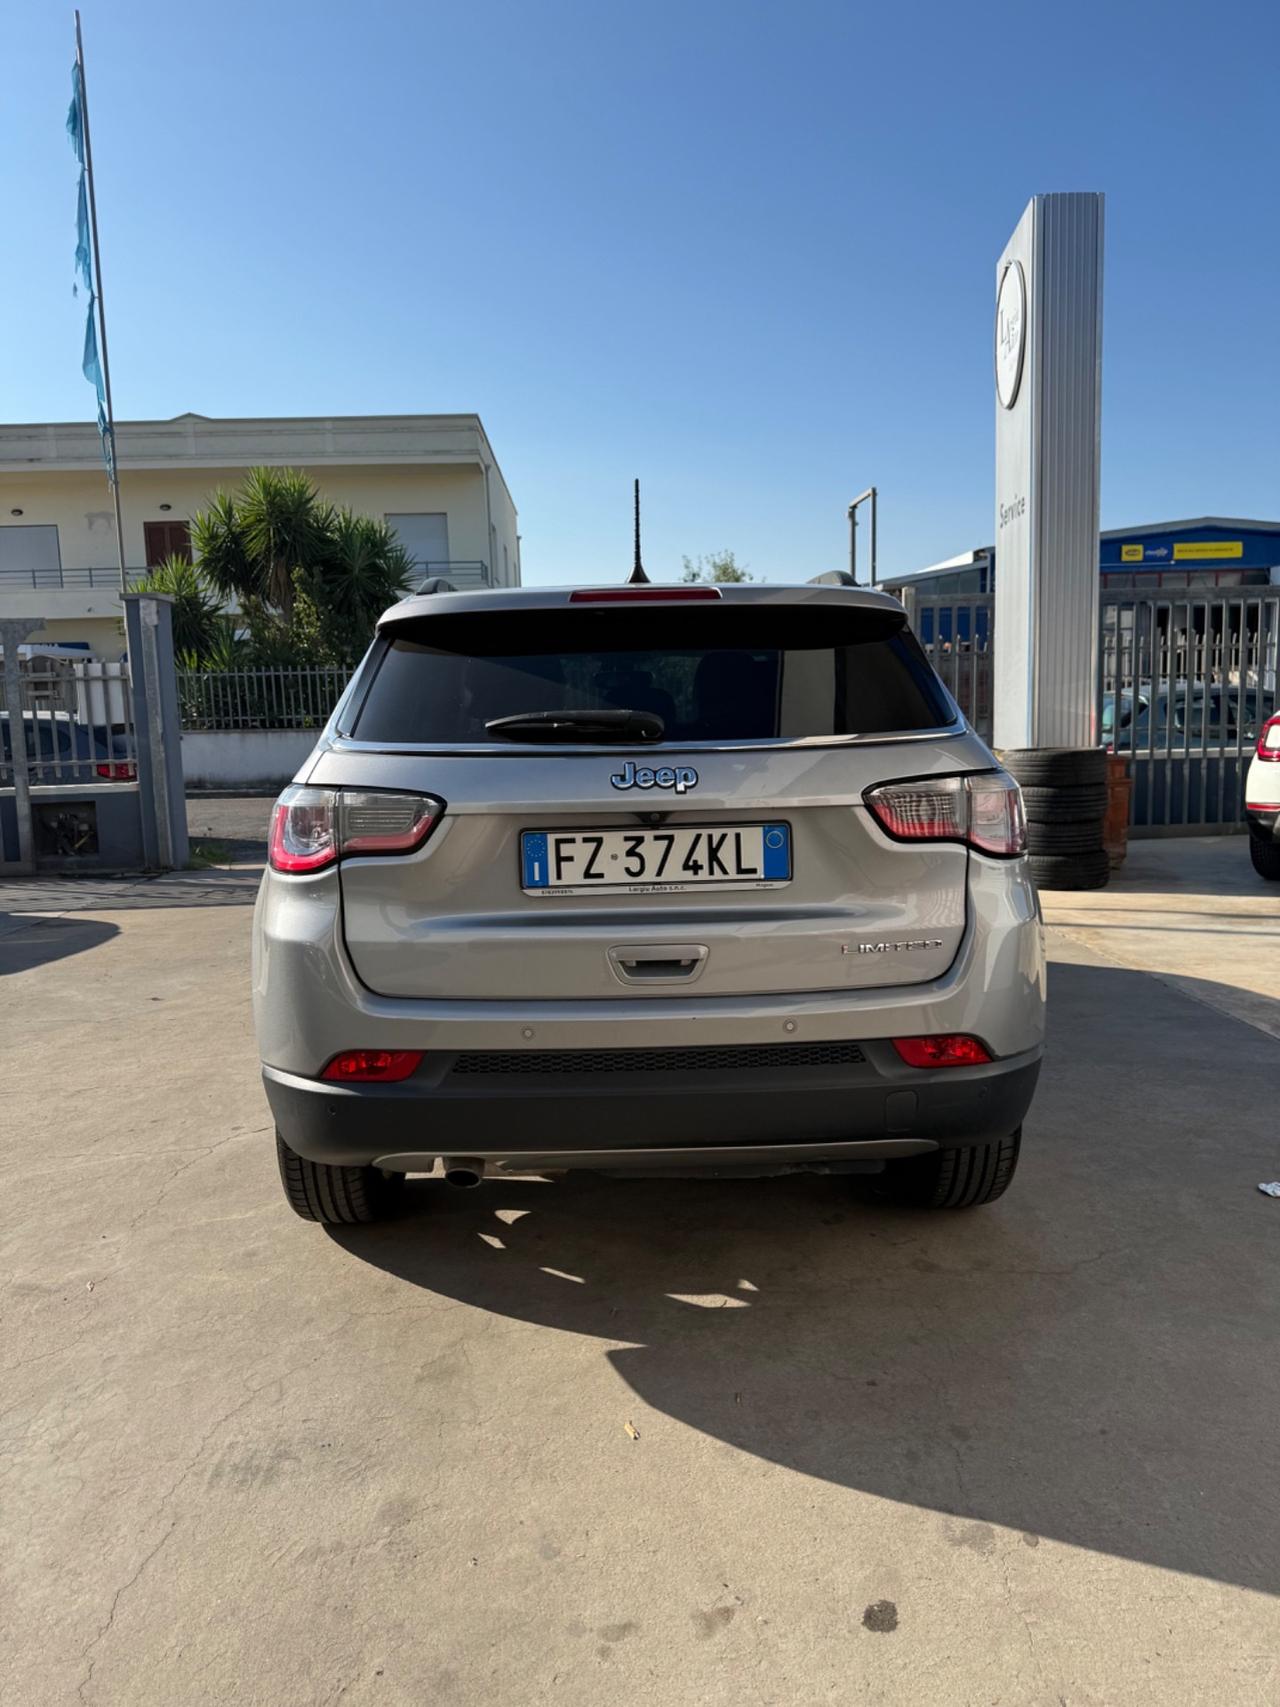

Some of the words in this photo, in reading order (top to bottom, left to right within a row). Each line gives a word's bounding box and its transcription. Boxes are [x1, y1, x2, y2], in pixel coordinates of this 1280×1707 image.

[1000, 493, 1025, 529] Service
[611, 761, 698, 794] Jeep
[533, 861, 540, 881] I
[554, 836, 605, 881] FZ
[623, 832, 758, 878] 374KL
[841, 939, 943, 955] LIMITED
